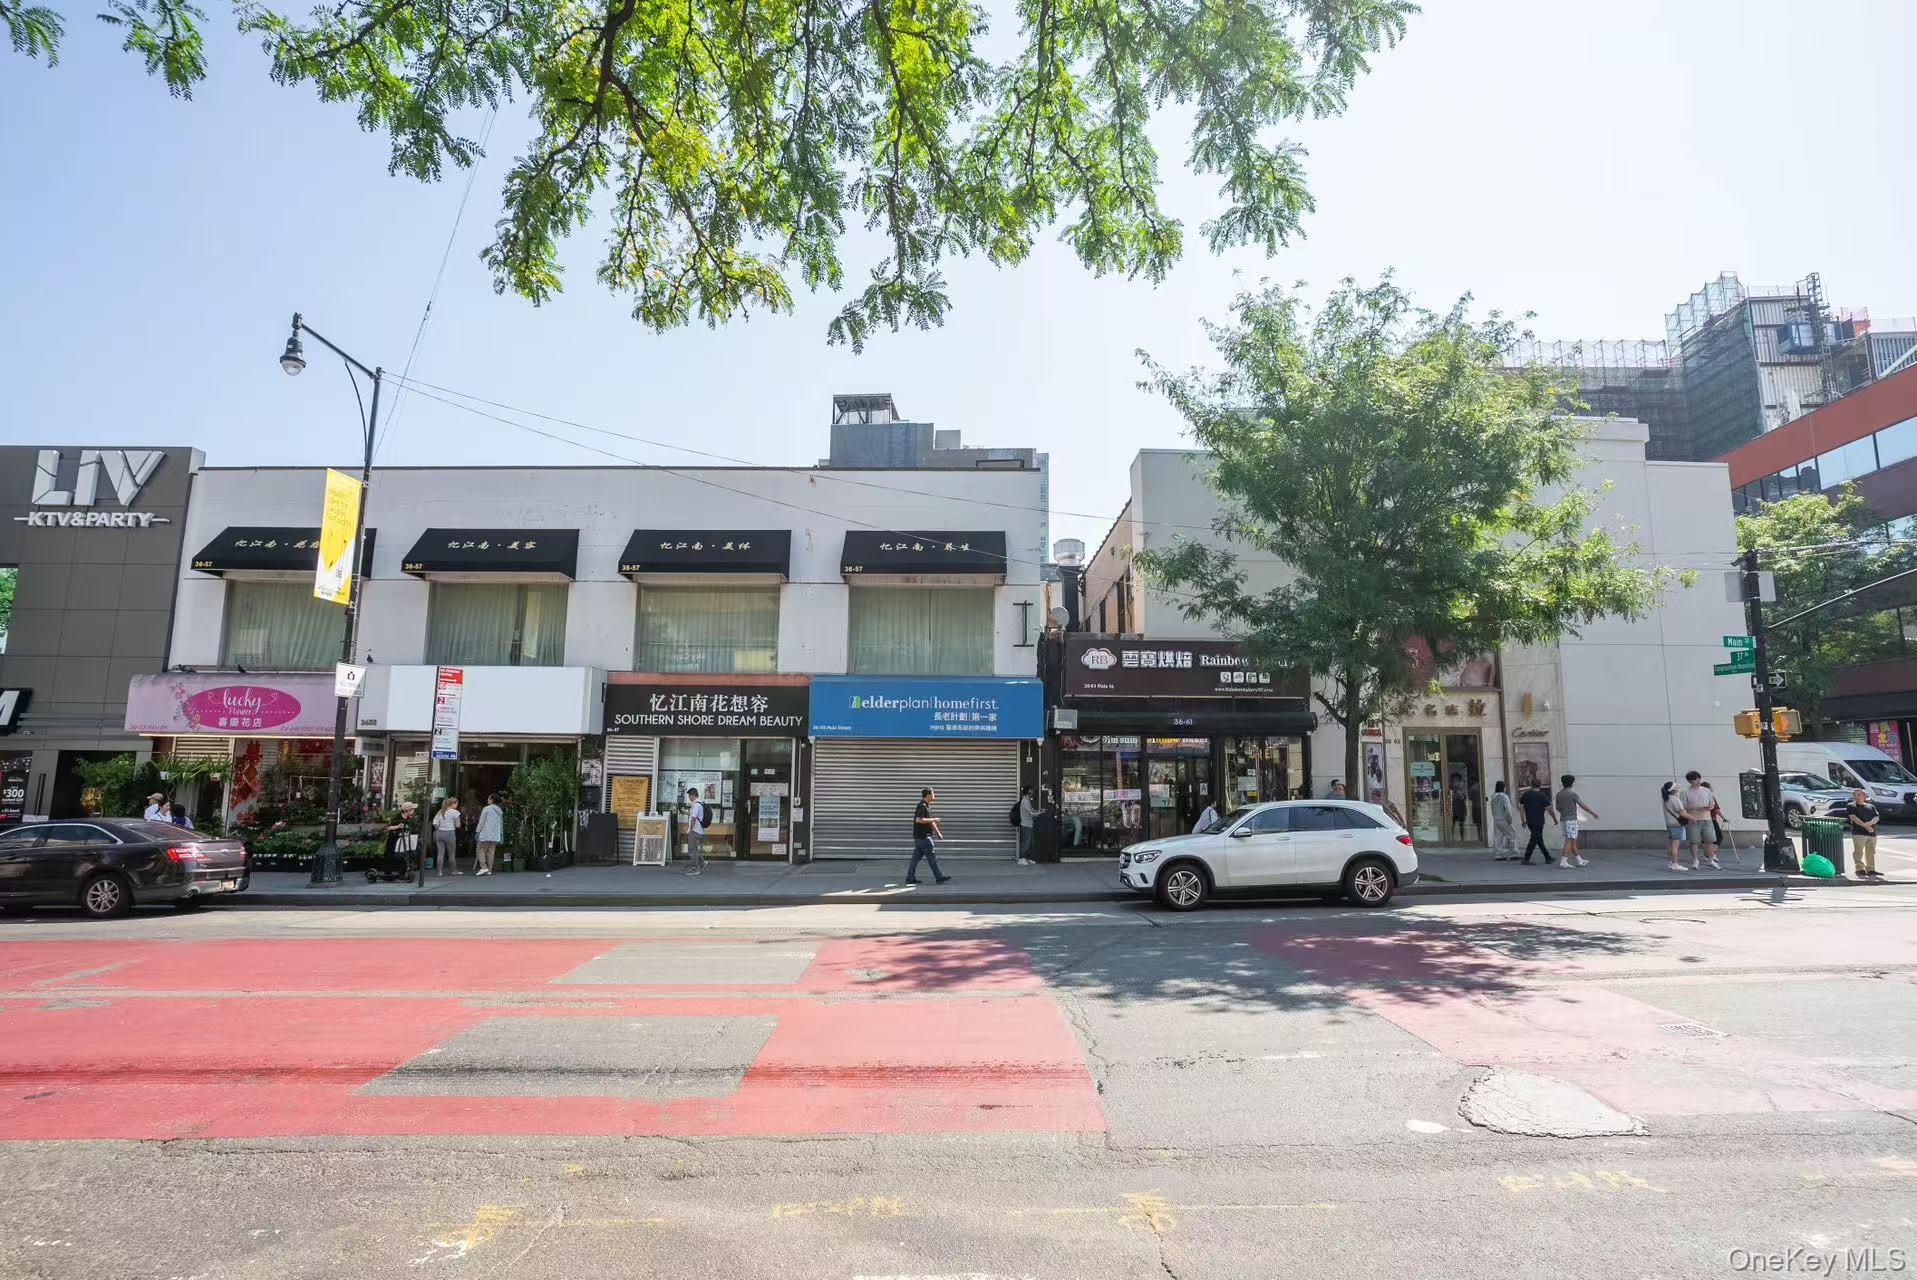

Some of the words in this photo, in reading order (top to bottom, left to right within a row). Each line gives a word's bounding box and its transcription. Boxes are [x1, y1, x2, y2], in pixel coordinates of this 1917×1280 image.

[32, 449, 167, 506] LIV
[28, 511, 153, 528] KTV&PARTY
[1728, 637, 1743, 646] Main
[1091, 655, 1109, 665] RB
[1200, 655, 1249, 666] Rainbow
[223, 687, 262, 714] lucky
[650, 694, 769, 713] 忆江南花想容
[614, 714, 674, 726] SOUTHERN
[677, 714, 715, 726] SHORE
[718, 715, 757, 727] DREAM
[760, 715, 803, 728] BEAUTY
[1511, 727, 1549, 738] Cartier
[3, 788, 25, 798] $300
